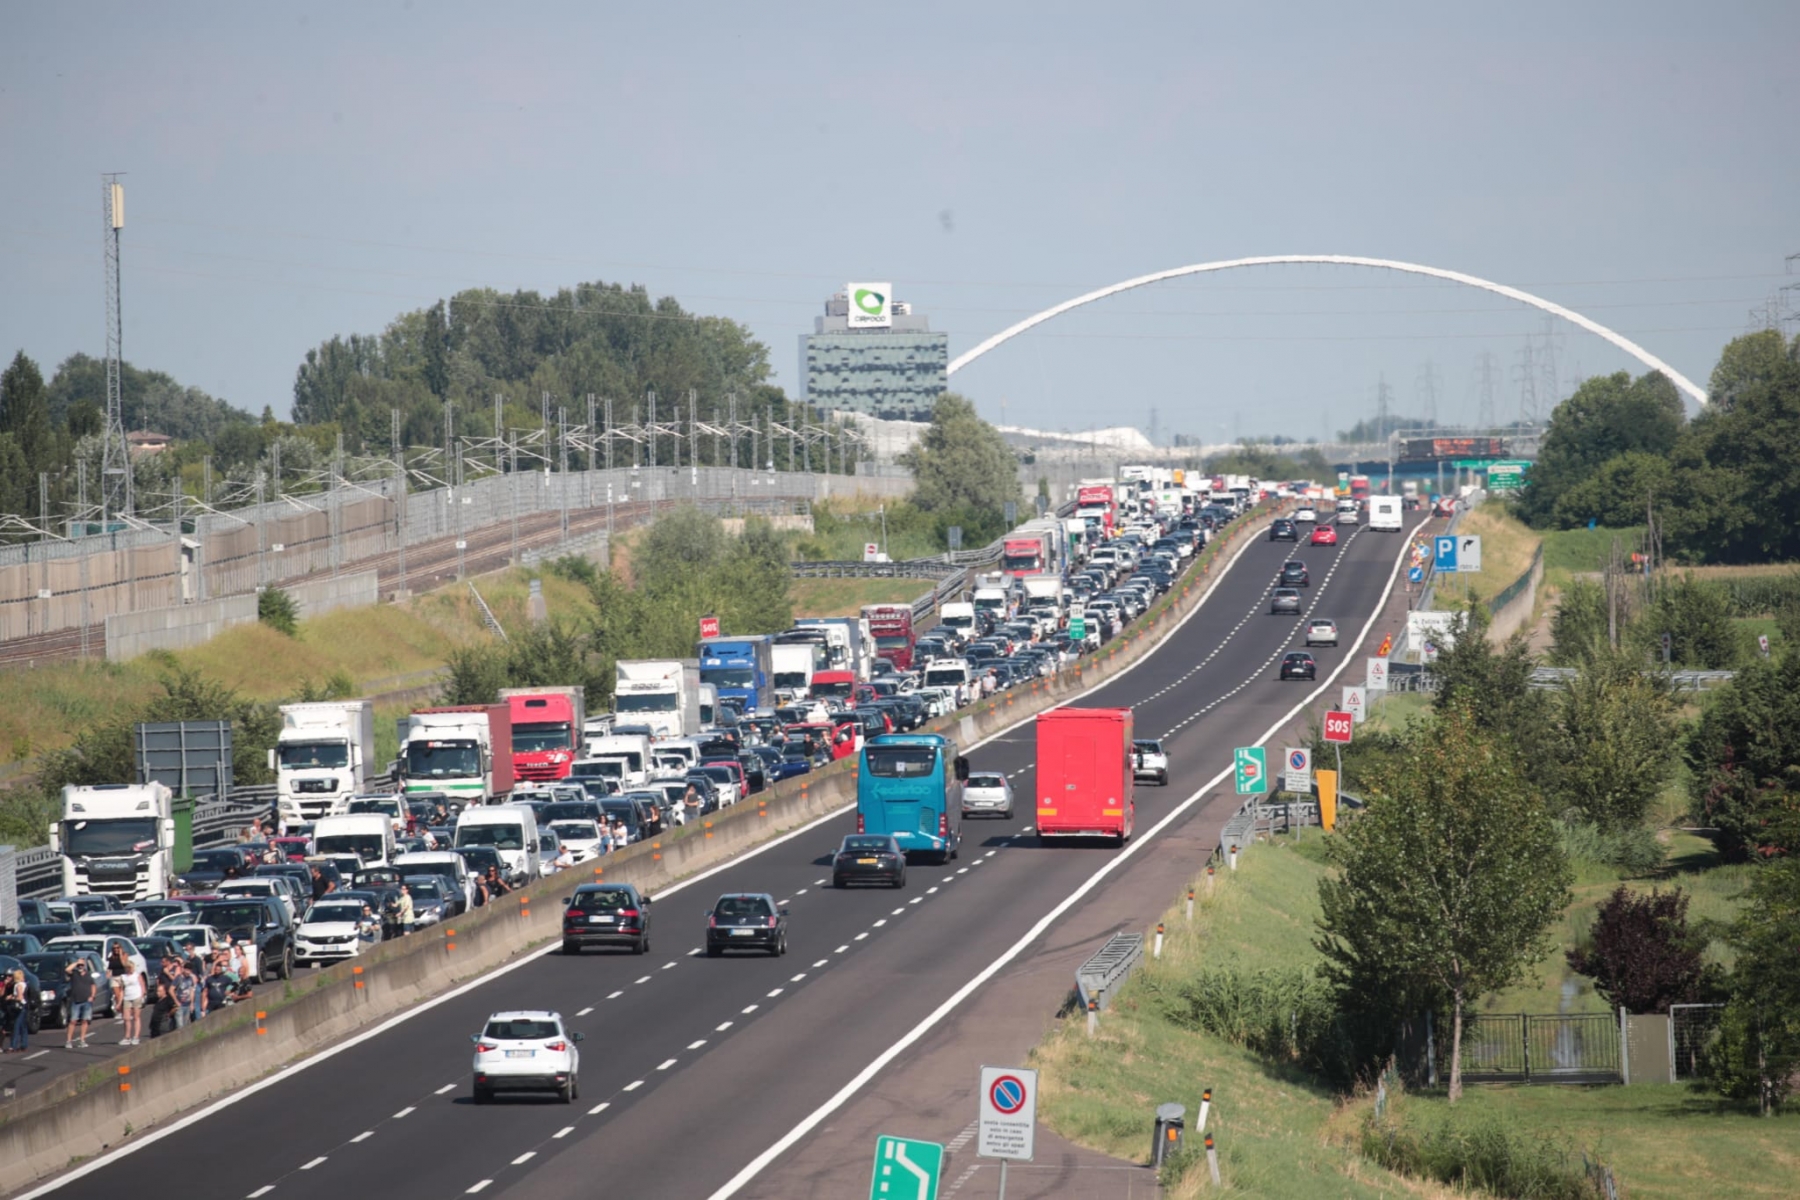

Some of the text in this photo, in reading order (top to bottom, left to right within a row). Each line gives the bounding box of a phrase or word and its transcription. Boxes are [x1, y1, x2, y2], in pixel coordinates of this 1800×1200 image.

[1438, 539, 1453, 558] P
[703, 623, 717, 633] SOS
[1327, 719, 1349, 734] SOS
